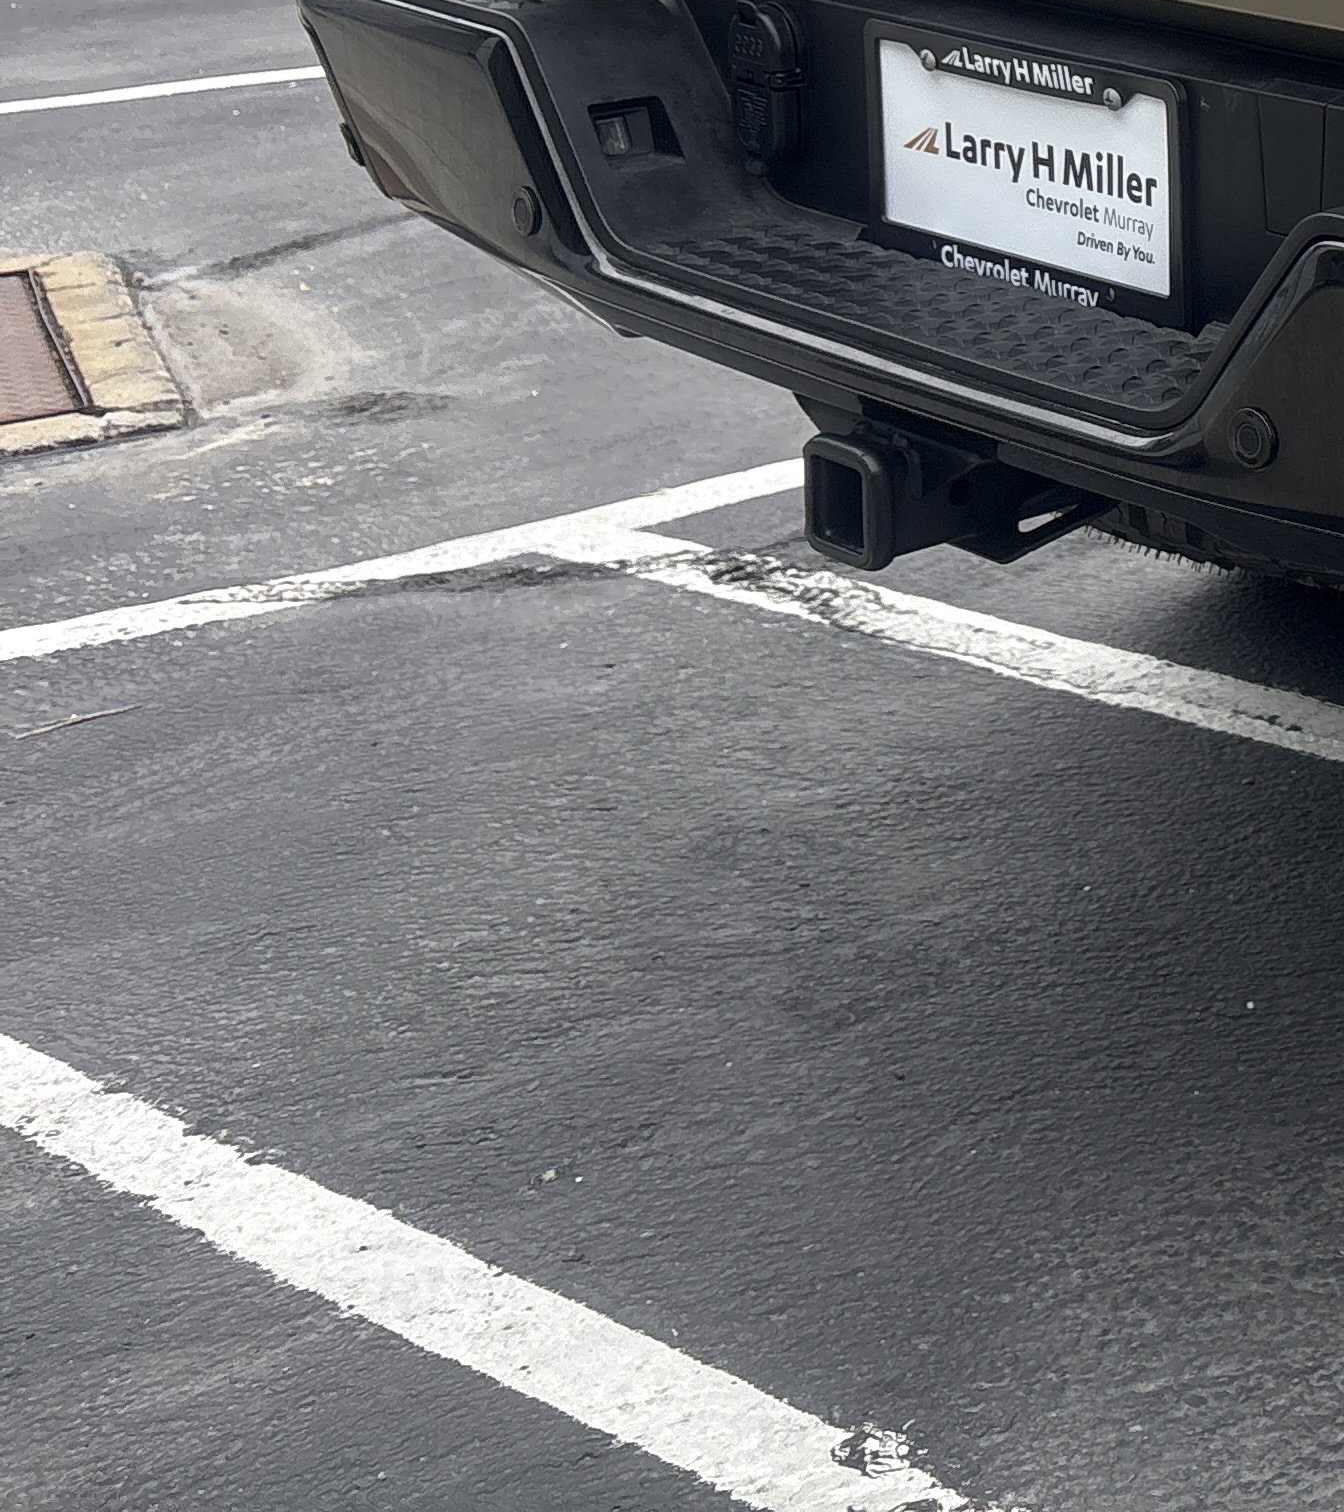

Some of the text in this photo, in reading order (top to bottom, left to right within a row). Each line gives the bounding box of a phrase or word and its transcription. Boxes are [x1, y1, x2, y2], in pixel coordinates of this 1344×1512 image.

[963, 46, 1094, 96] Larry H Miller
[945, 121, 1157, 207] Larry H Miller
[1026, 188, 1154, 242] Chevrolet Murray
[1077, 231, 1114, 254] Driven
[1117, 242, 1131, 262] By
[941, 244, 1099, 308] Chevrolet Murray
